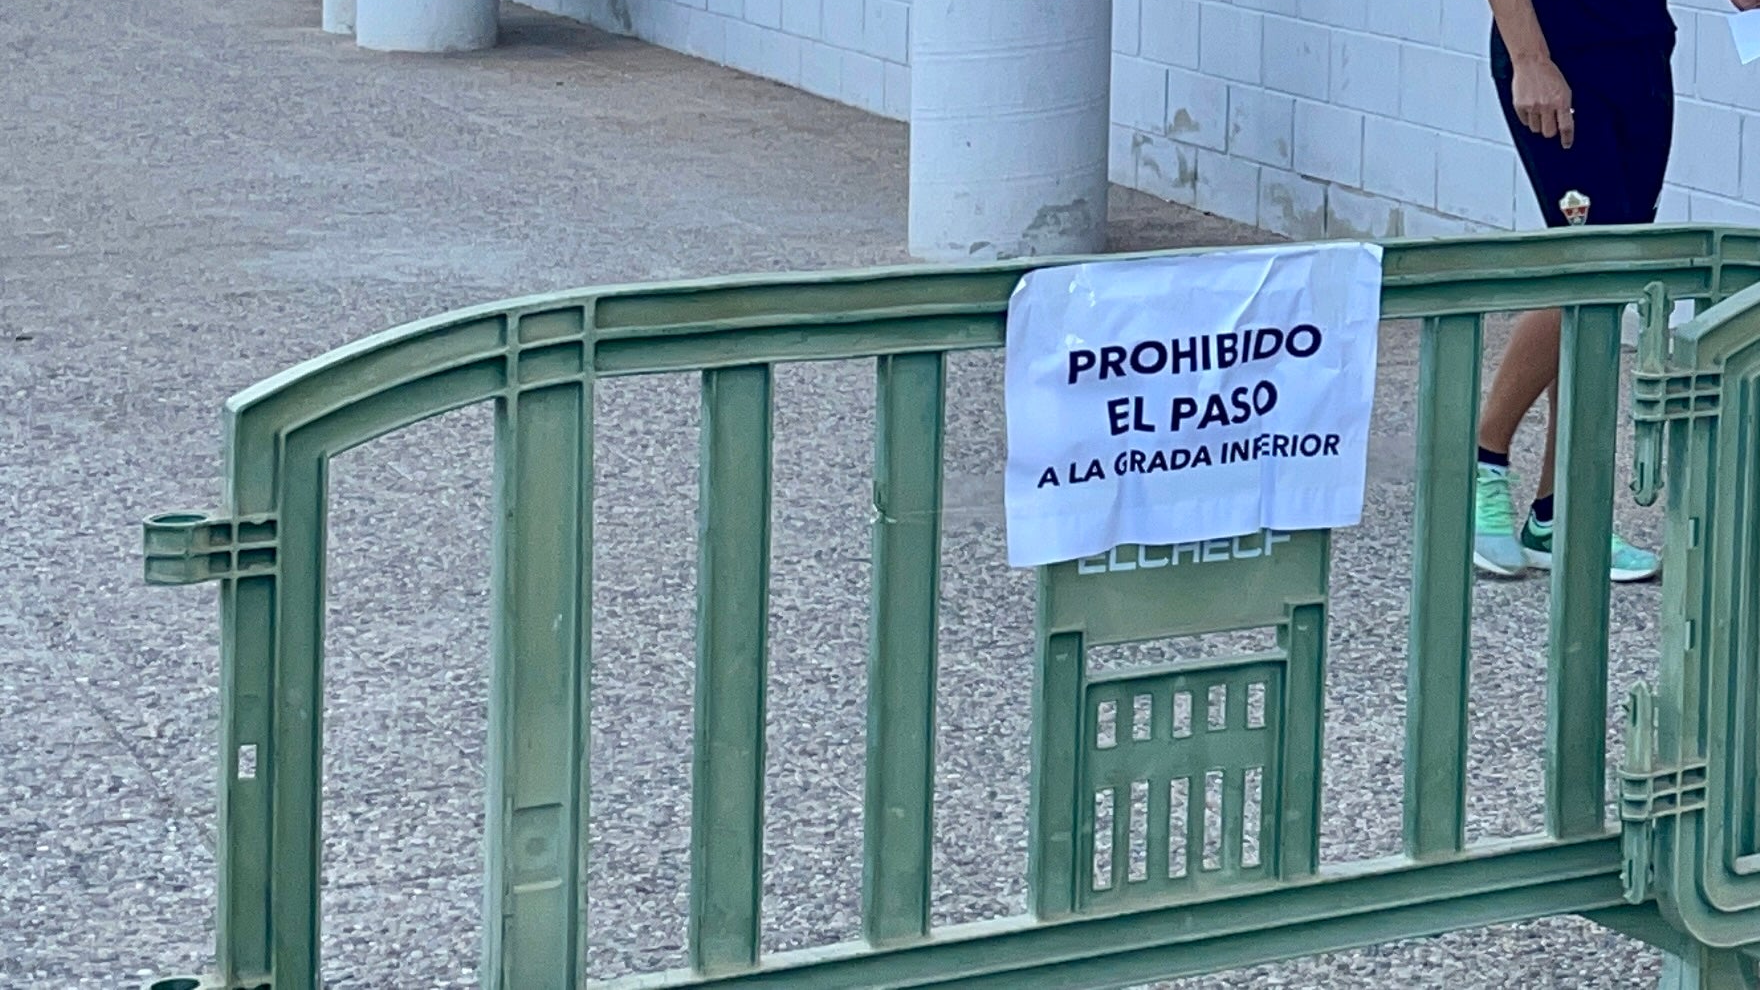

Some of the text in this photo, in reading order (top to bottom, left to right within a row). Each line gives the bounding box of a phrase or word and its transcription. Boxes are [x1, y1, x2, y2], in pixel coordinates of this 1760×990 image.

[1068, 324, 1322, 384] PROHIBIDO
[1107, 380, 1278, 436] EL PASO
[1037, 433, 1340, 489] A LA GRADA INFERIOR
